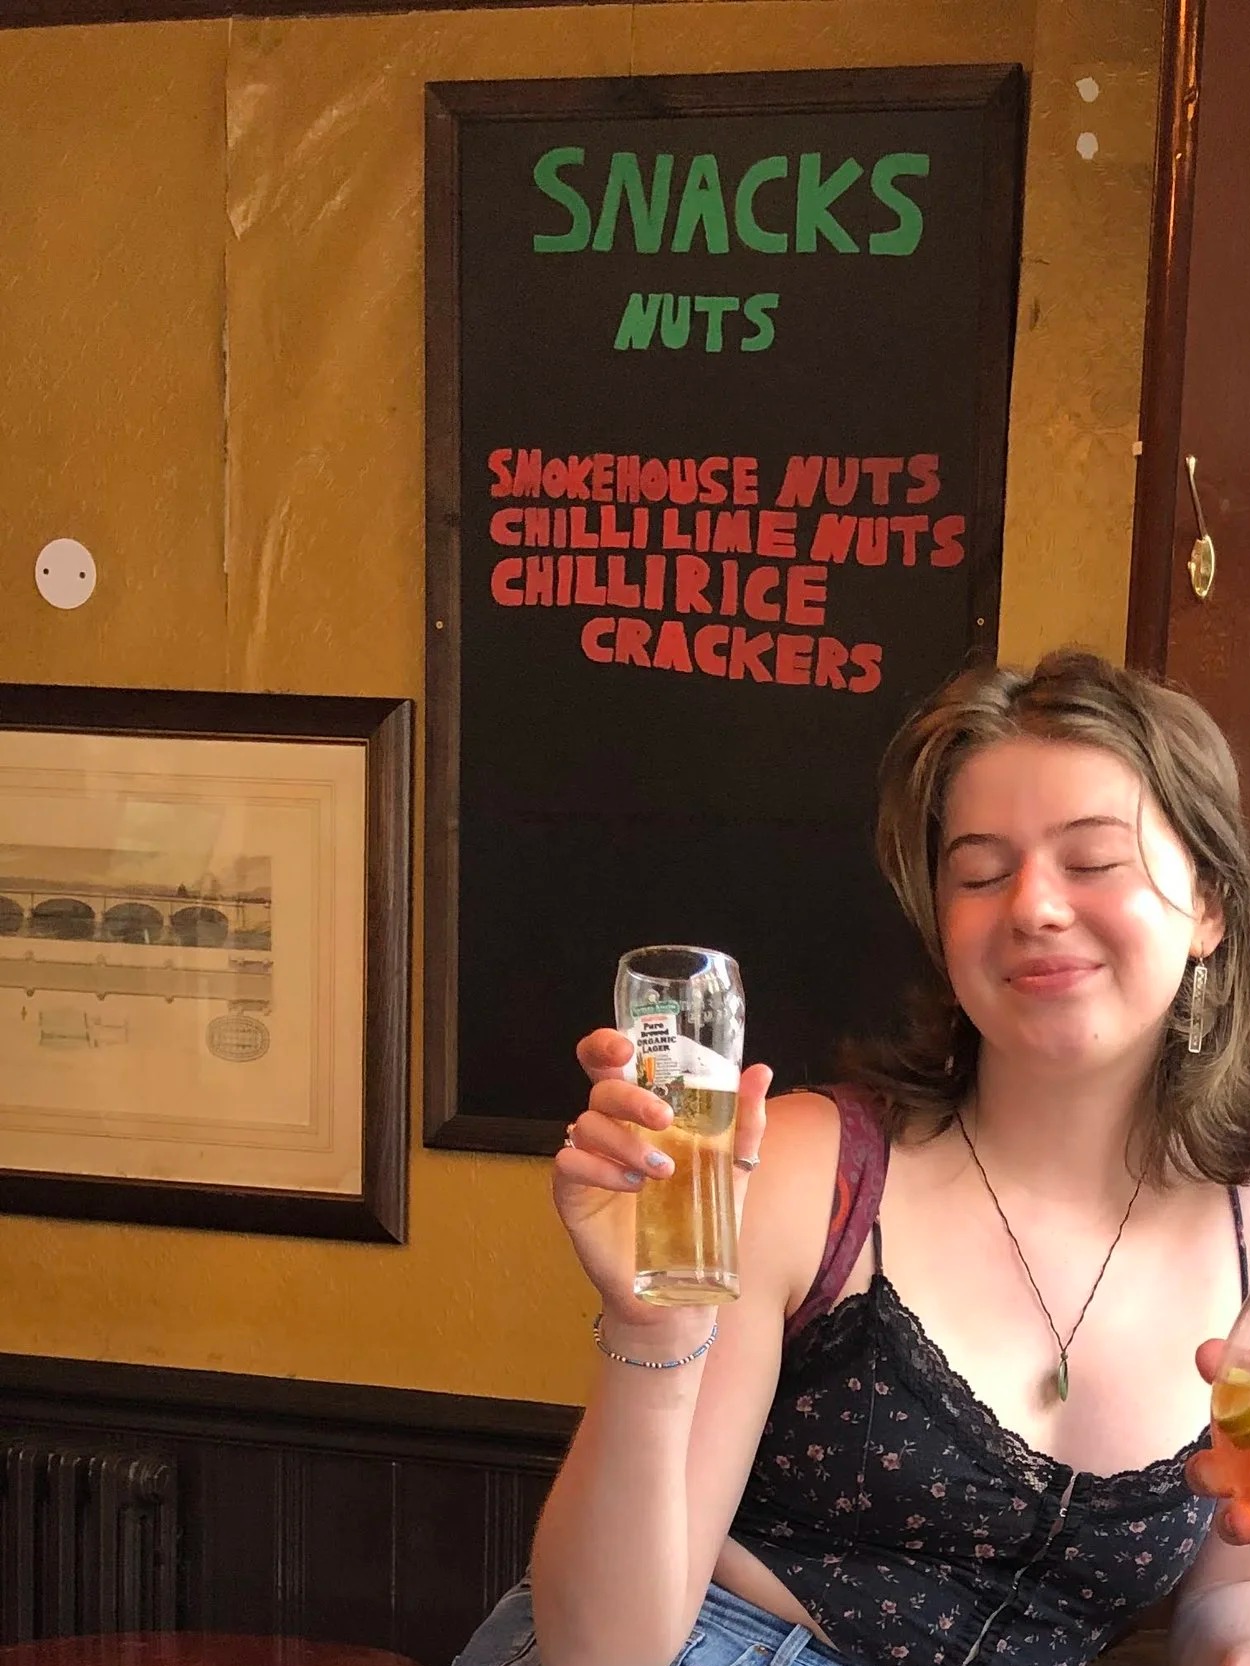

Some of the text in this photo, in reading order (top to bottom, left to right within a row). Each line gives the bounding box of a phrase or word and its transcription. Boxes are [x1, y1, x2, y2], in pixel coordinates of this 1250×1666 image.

[533, 147, 930, 256] SNACKS
[614, 292, 780, 353] NUTS
[487, 448, 941, 508] SMOKEHOUSE NUTS
[489, 506, 966, 568] CHILLI LIME NUTS
[490, 554, 829, 627] CHILLI RICE
[580, 616, 883, 694] CRACKERS
[636, 1036, 677, 1047] ORGANIC
[642, 1045, 670, 1054] LAGER
